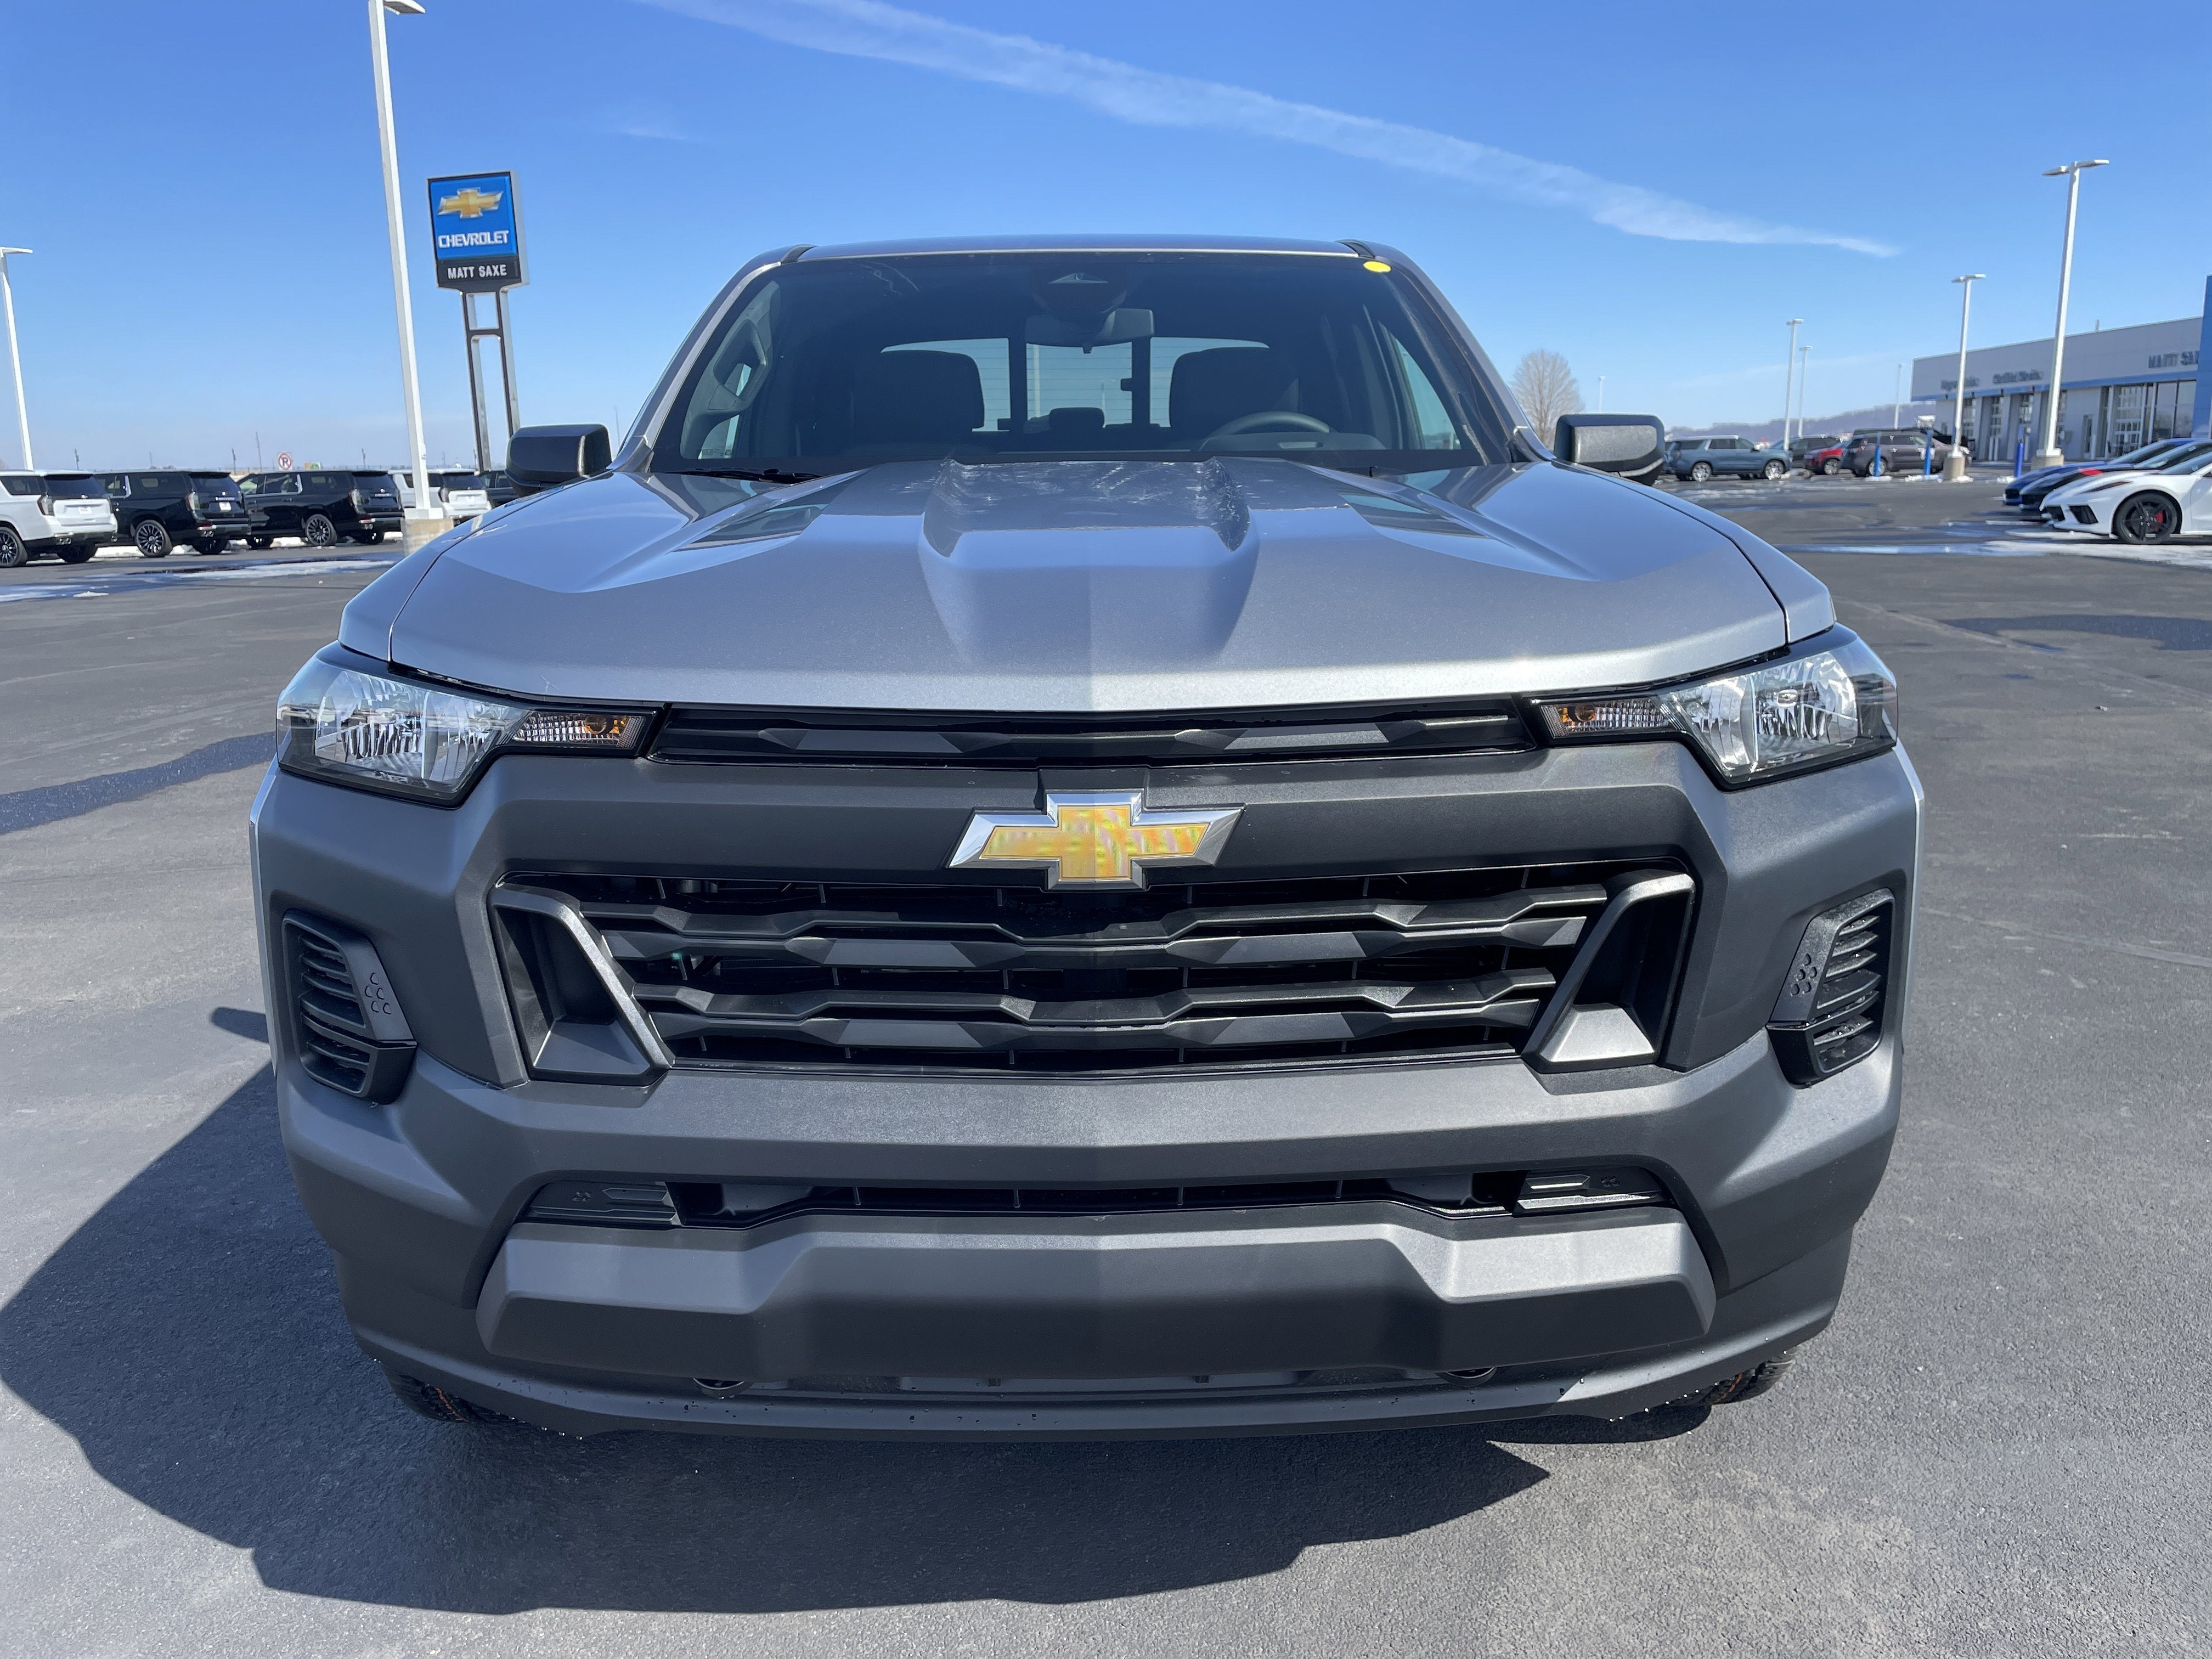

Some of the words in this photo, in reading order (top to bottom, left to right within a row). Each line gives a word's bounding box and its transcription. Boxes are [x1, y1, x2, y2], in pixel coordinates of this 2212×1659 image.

[438, 230, 509, 249] CHEVROLET
[447, 266, 475, 279] MATT
[478, 264, 507, 278] SAXE
